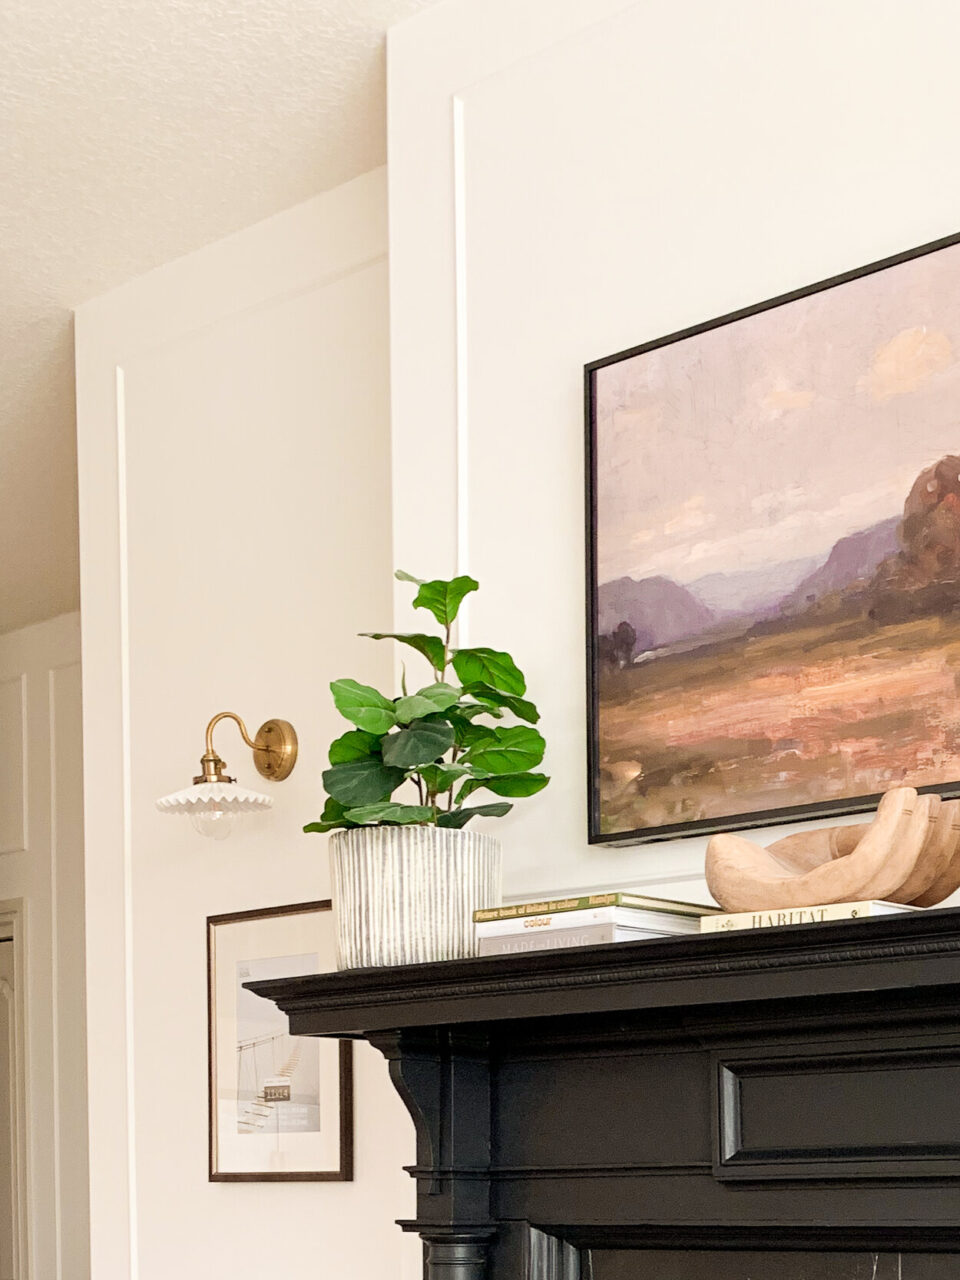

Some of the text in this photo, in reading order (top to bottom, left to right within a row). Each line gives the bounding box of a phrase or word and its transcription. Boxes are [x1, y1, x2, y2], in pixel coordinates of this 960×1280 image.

[523, 917, 553, 928] colour
[752, 909, 828, 929] HABITAT
[502, 940, 536, 954] MADE
[546, 934, 590, 950] LIVING
